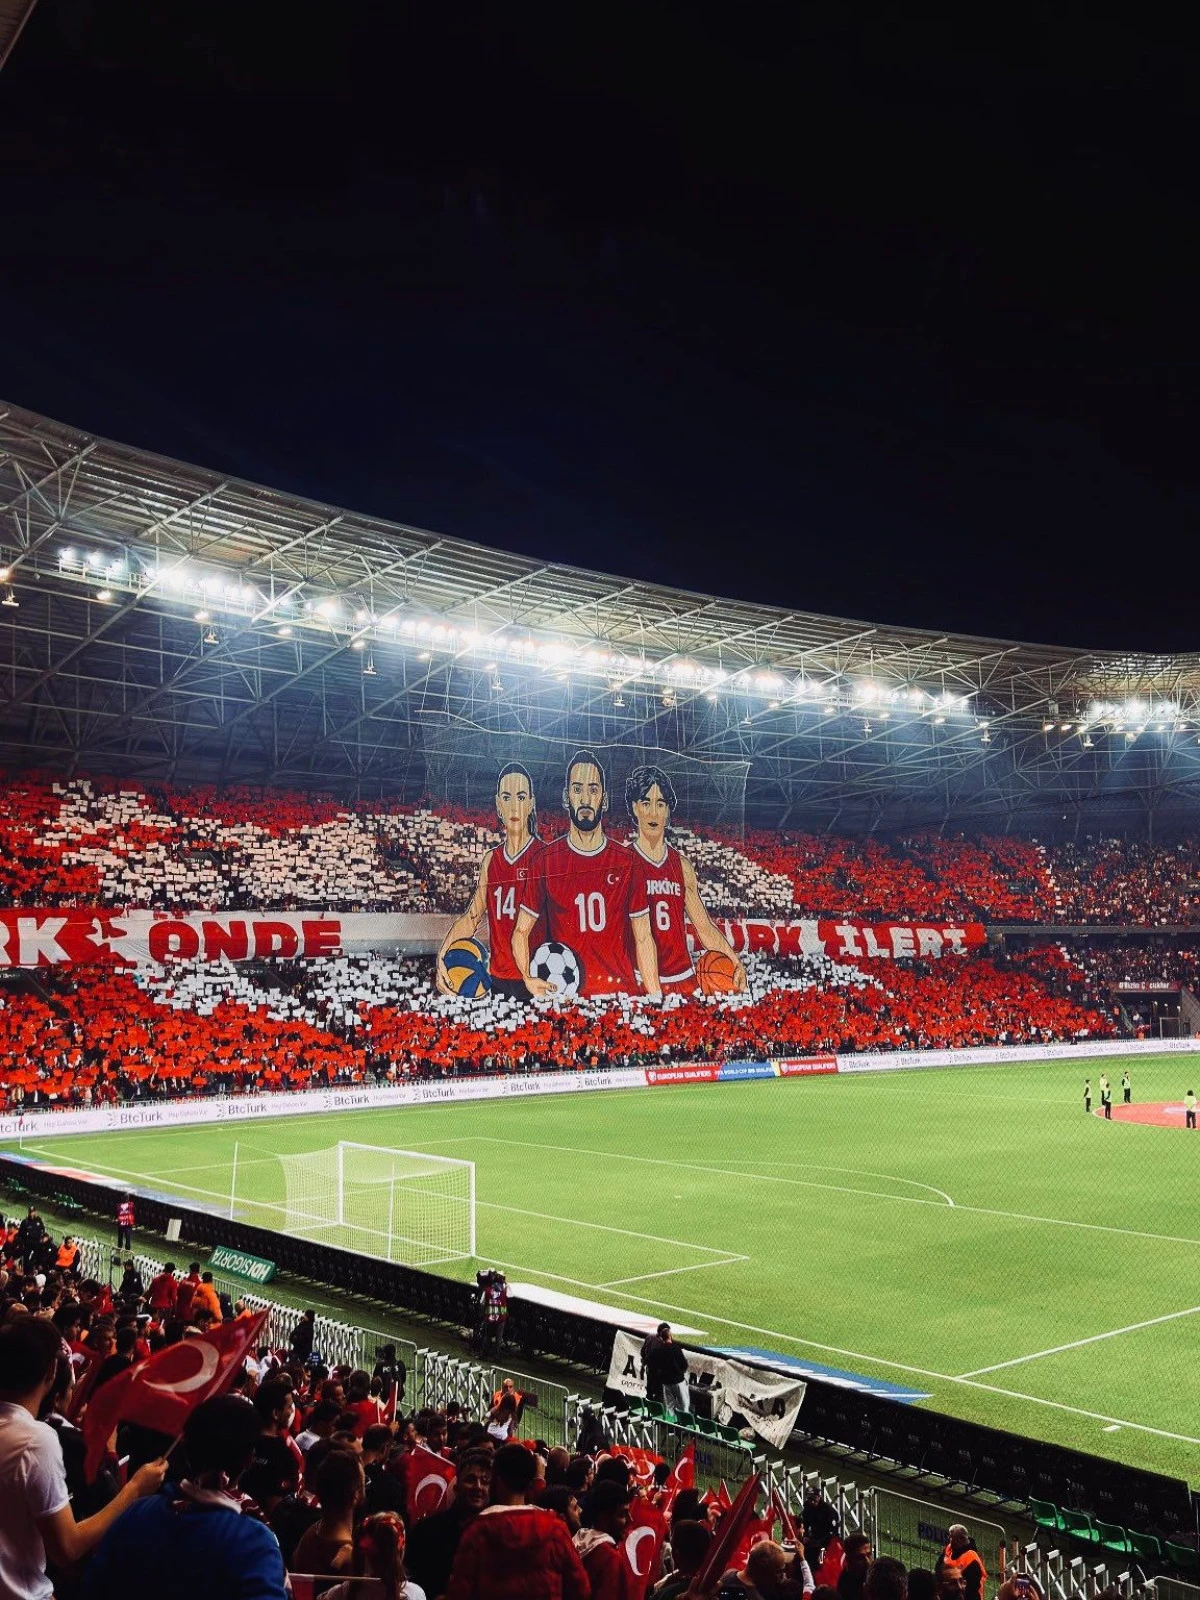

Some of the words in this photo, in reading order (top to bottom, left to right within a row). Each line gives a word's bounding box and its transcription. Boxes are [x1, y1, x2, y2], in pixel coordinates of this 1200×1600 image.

[494, 886, 516, 920] 14
[575, 891, 606, 932] 10
[656, 901, 670, 931] 6
[0, 917, 72, 965] K
[510, 1082, 541, 1092] BtcTurk
[584, 1076, 612, 1086] BtcTurk
[422, 1088, 455, 1099] BtcTurk
[334, 1094, 370, 1106] BtcTurk
[228, 1103, 267, 1115] BtcTurk
[120, 1111, 163, 1124] BtcTurk
